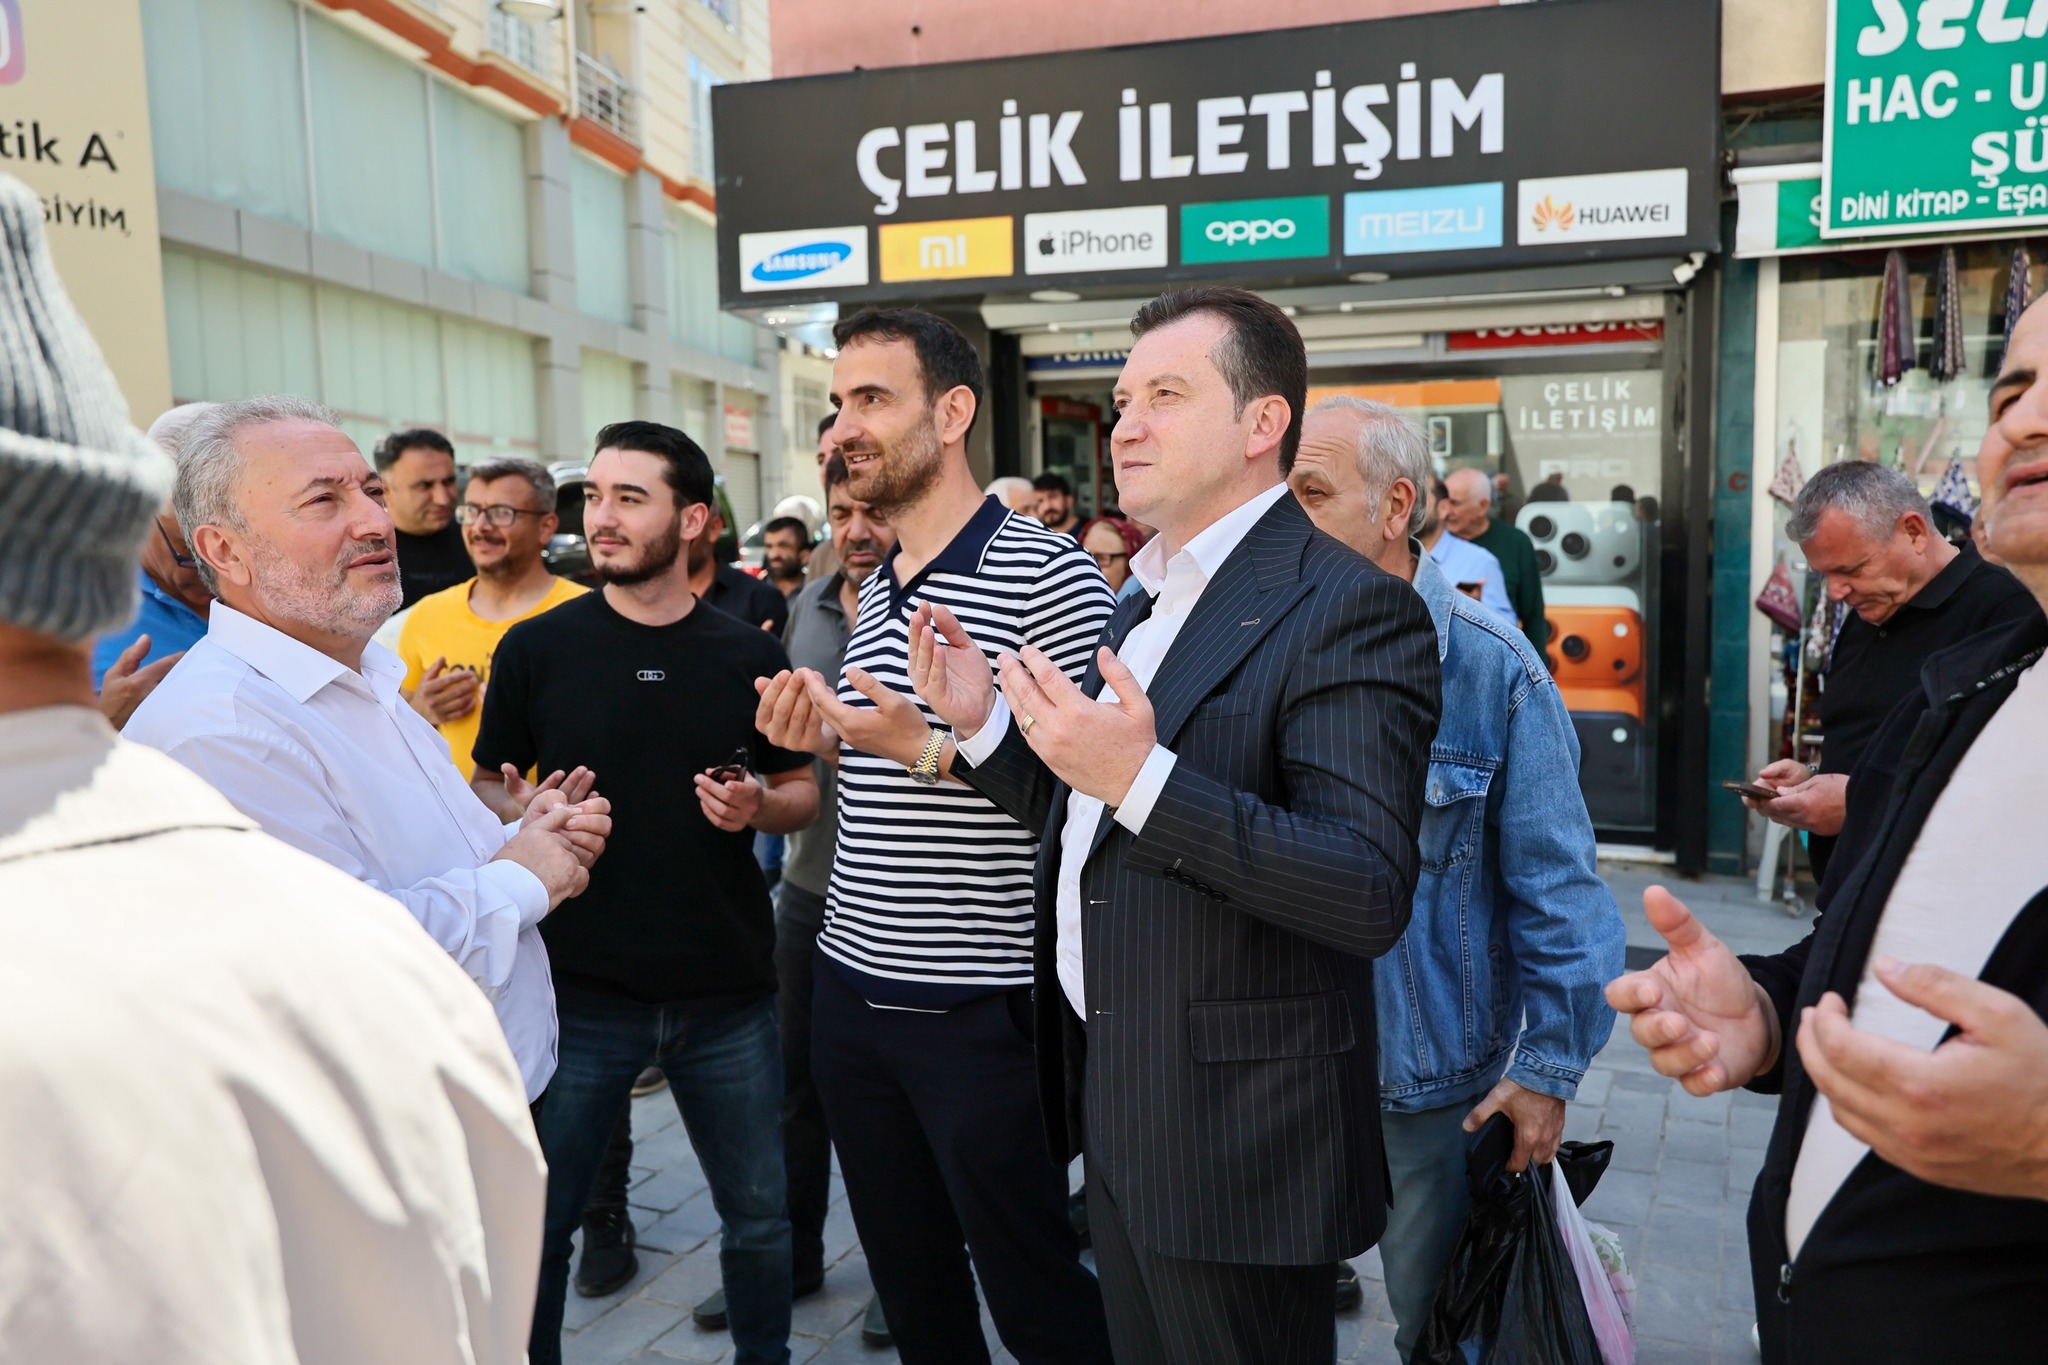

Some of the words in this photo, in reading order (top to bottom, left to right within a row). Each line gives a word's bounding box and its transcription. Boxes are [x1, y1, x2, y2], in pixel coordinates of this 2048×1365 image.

[1847, 70, 1959, 125] HAC
[79, 132, 118, 172] A
[856, 98, 1087, 216] ÇELİK
[1119, 62, 1504, 181] İLETİŞİM
[1970, 115, 2048, 189] ŞÜ
[1578, 204, 1669, 226] HUAWEI
[1896, 188, 1970, 219] KİTAP
[1061, 230, 1154, 255] iPhone
[761, 250, 842, 274] SAMSUNG
[1544, 377, 1631, 407] ÇELİK
[1519, 404, 1656, 433] İLETİŞİM
